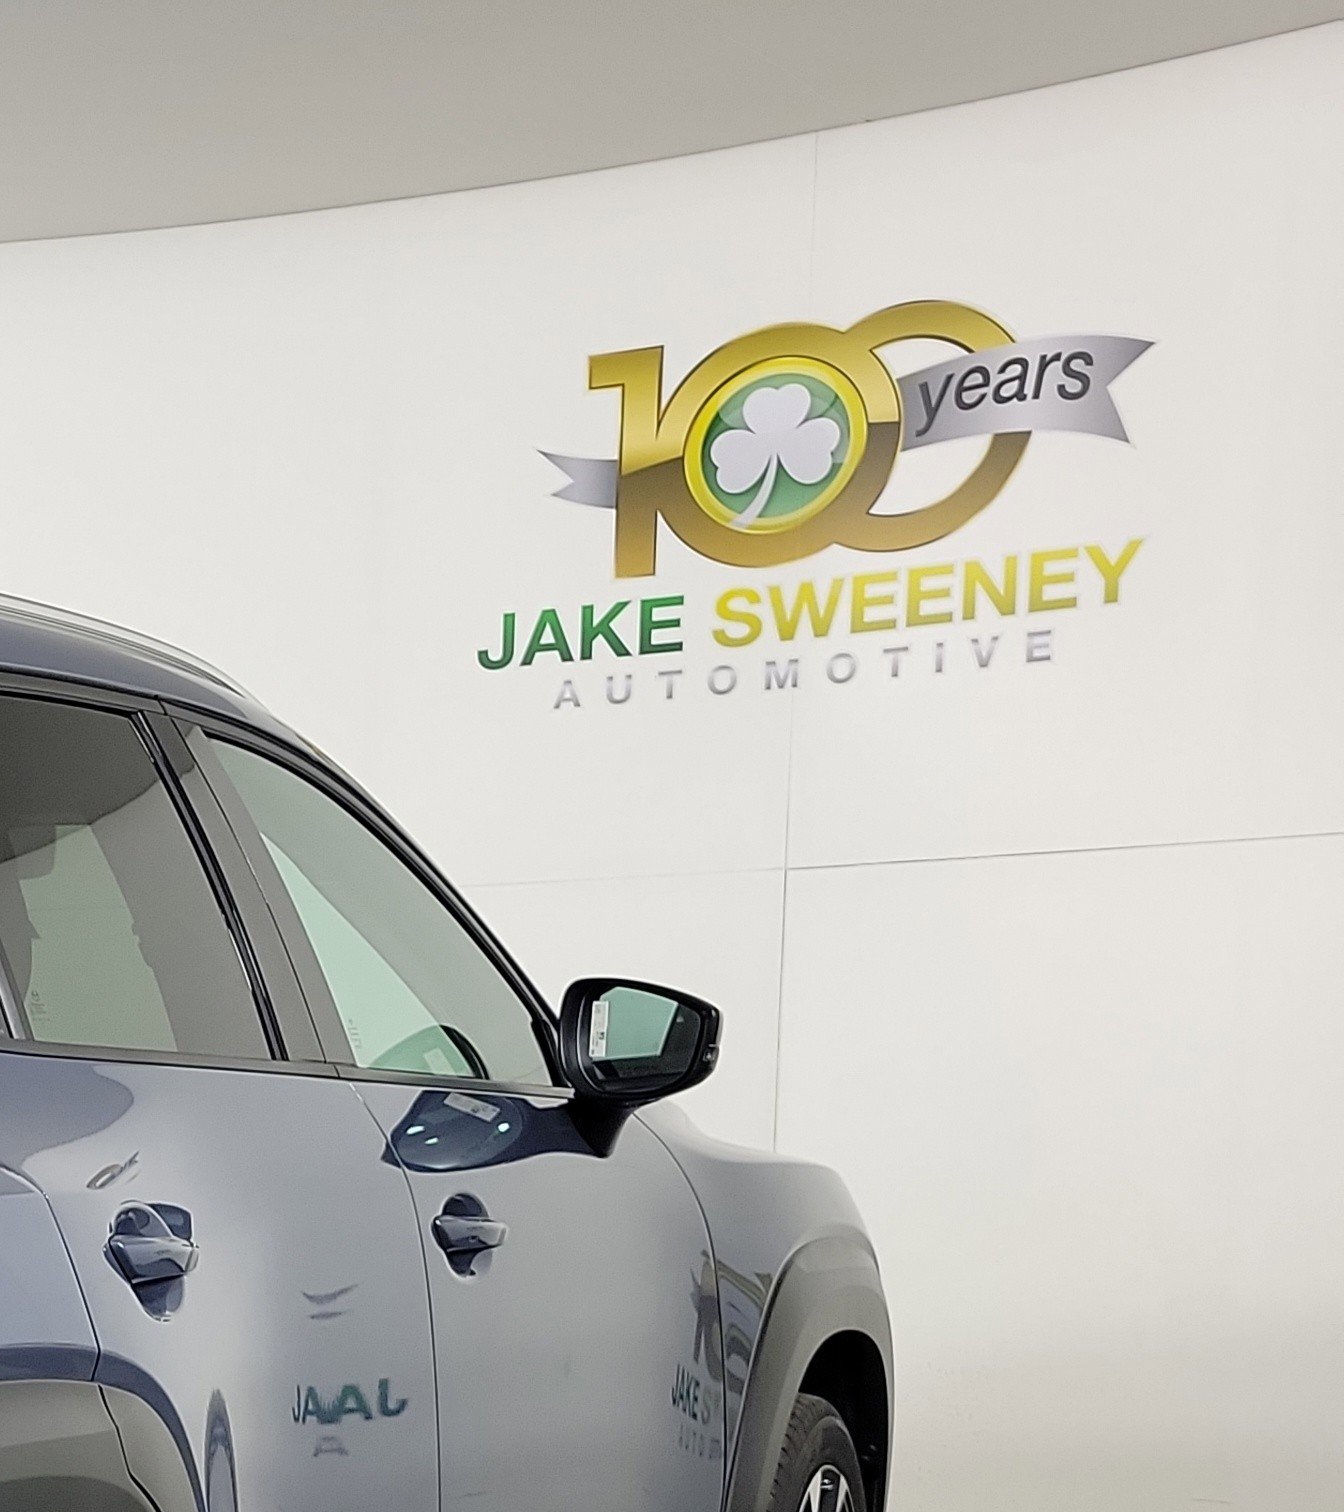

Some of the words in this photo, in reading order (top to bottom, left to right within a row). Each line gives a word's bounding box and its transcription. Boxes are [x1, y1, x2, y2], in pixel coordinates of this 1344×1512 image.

[915, 348, 1095, 437] years
[476, 595, 687, 671] JAKE
[711, 537, 1144, 649] SWEENEY
[552, 628, 1056, 710] AUTOMOTIVE
